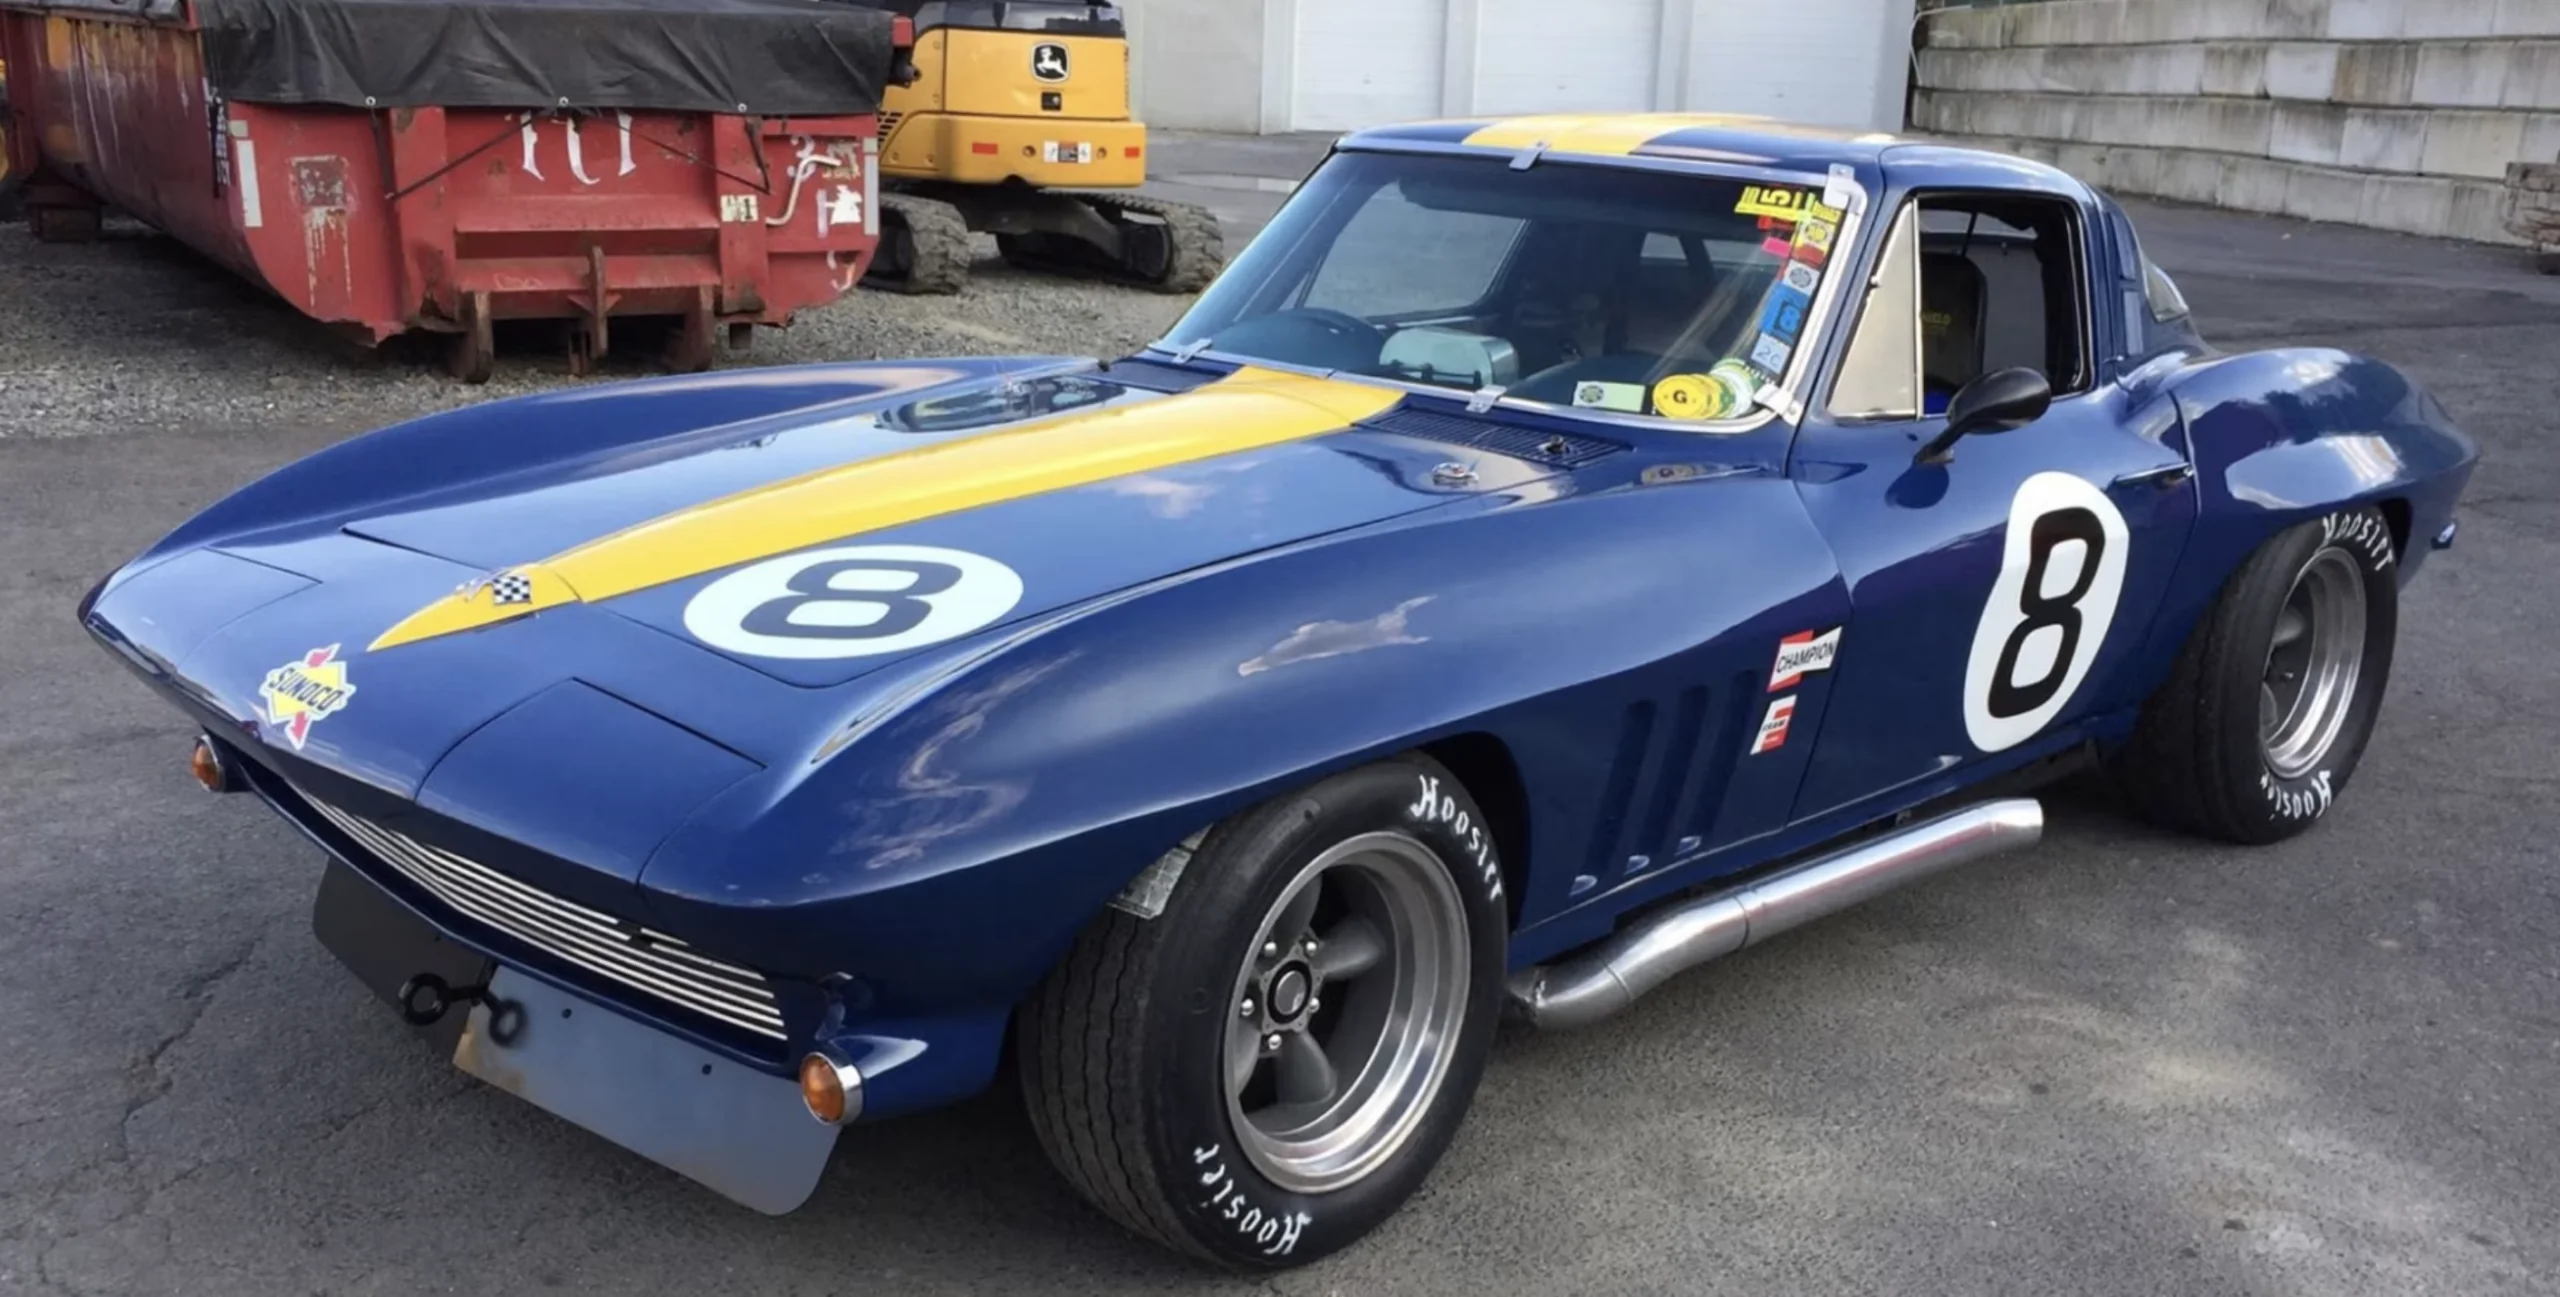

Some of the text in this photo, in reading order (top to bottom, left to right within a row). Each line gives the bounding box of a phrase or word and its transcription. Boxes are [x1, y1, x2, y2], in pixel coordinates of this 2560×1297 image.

[1673, 391, 1687, 404] G
[740, 559, 963, 640] 8
[1988, 506, 2106, 719] 8
[268, 667, 344, 711] SUNOCO
[1777, 642, 1835, 673] CHAMPION
[1410, 774, 1502, 902] Hoosier
[1194, 1144, 1312, 1254] Hoosier
